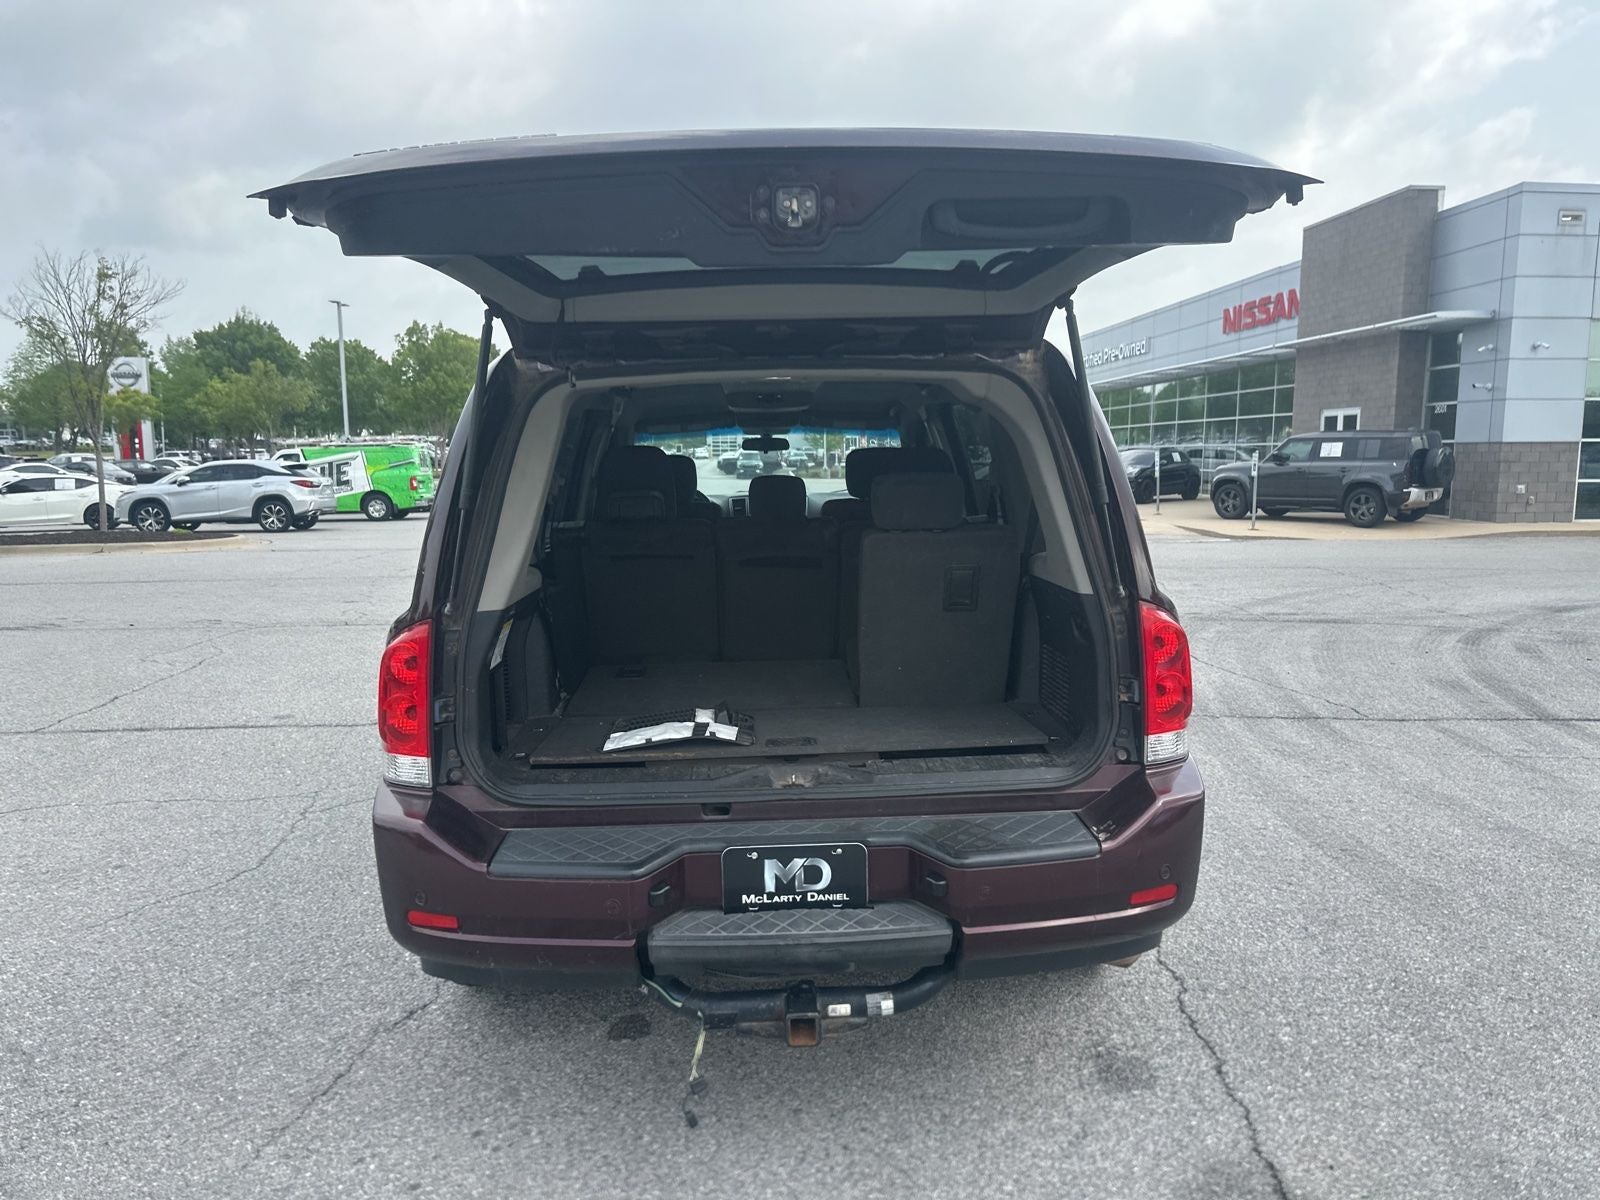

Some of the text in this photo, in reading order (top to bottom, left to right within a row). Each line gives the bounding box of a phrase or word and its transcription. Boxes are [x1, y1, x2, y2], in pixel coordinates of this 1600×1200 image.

[1222, 288, 1300, 335] NISSAN
[1103, 336, 1147, 363] Pre-Owned
[741, 892, 850, 904] McLARTY DANIEL
